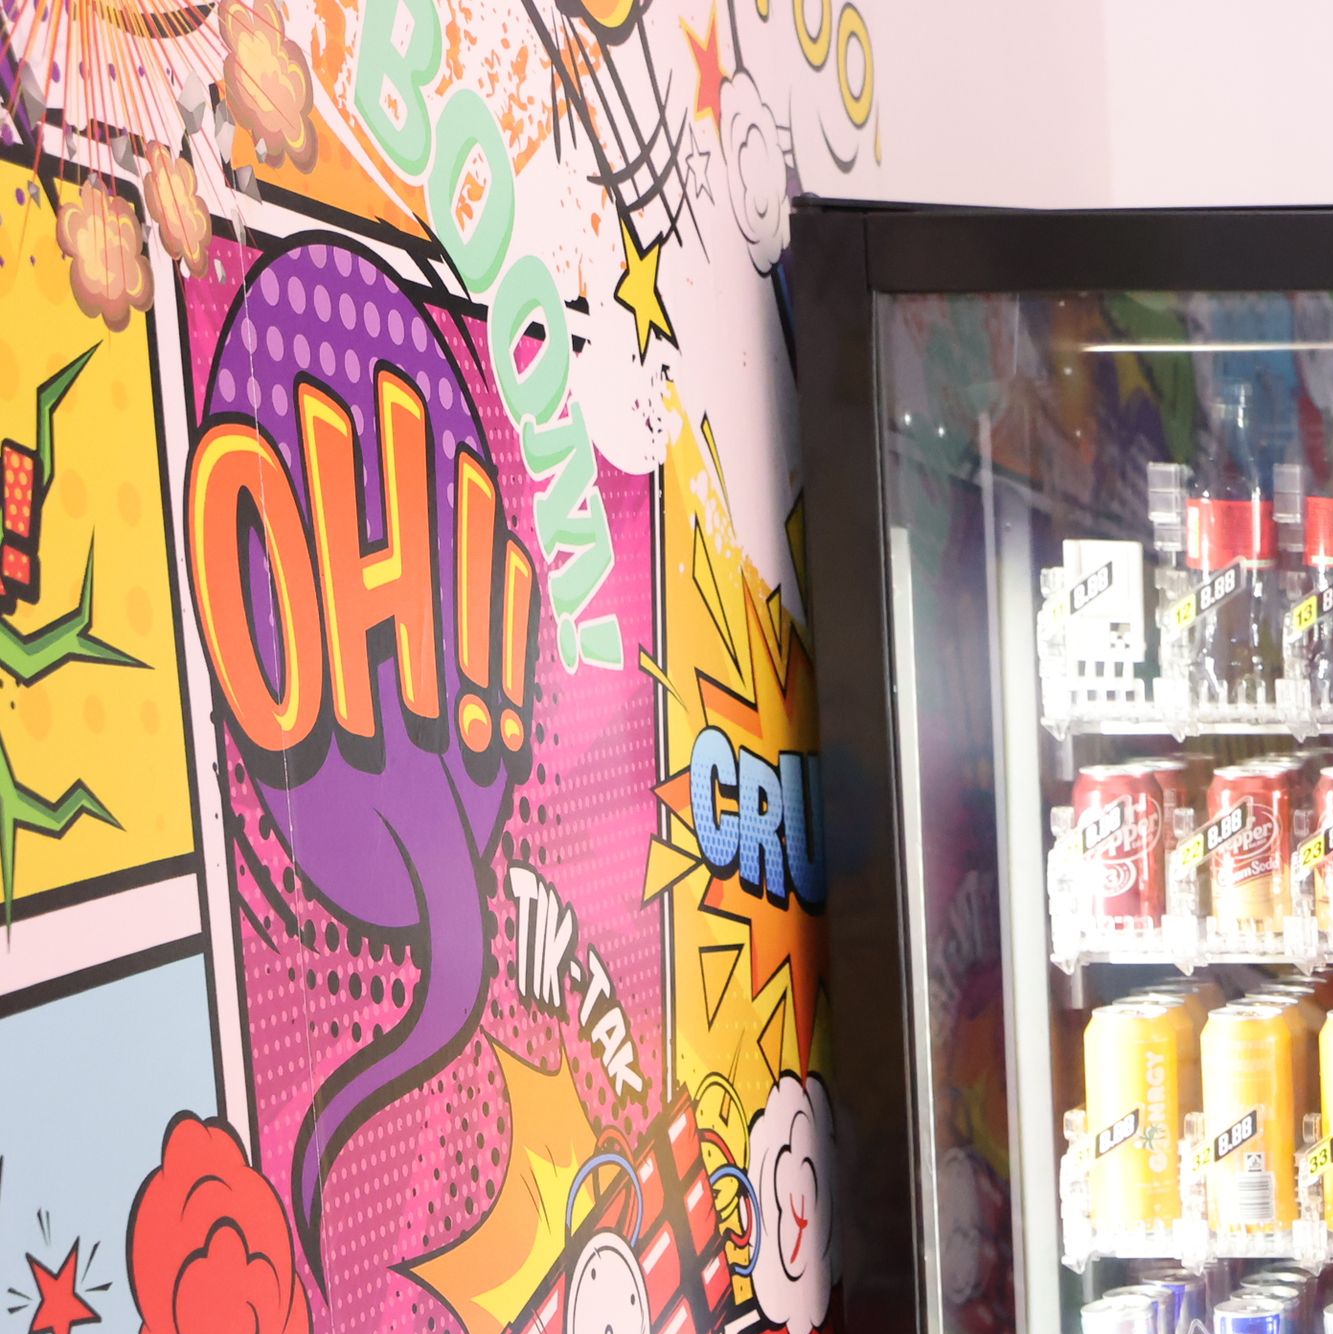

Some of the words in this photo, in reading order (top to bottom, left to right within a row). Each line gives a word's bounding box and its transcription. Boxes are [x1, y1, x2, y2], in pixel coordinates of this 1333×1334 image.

[355, 0, 624, 675] BOOM!
[188, 363, 540, 765] OH!!
[1200, 569, 1236, 610] 8.88
[1295, 602, 1313, 625] 13
[1207, 807, 1243, 849] 8.88
[1302, 843, 1323, 866] 23
[510, 867, 643, 1094] TIK-TAK
[1309, 1148, 1329, 1175] 33
